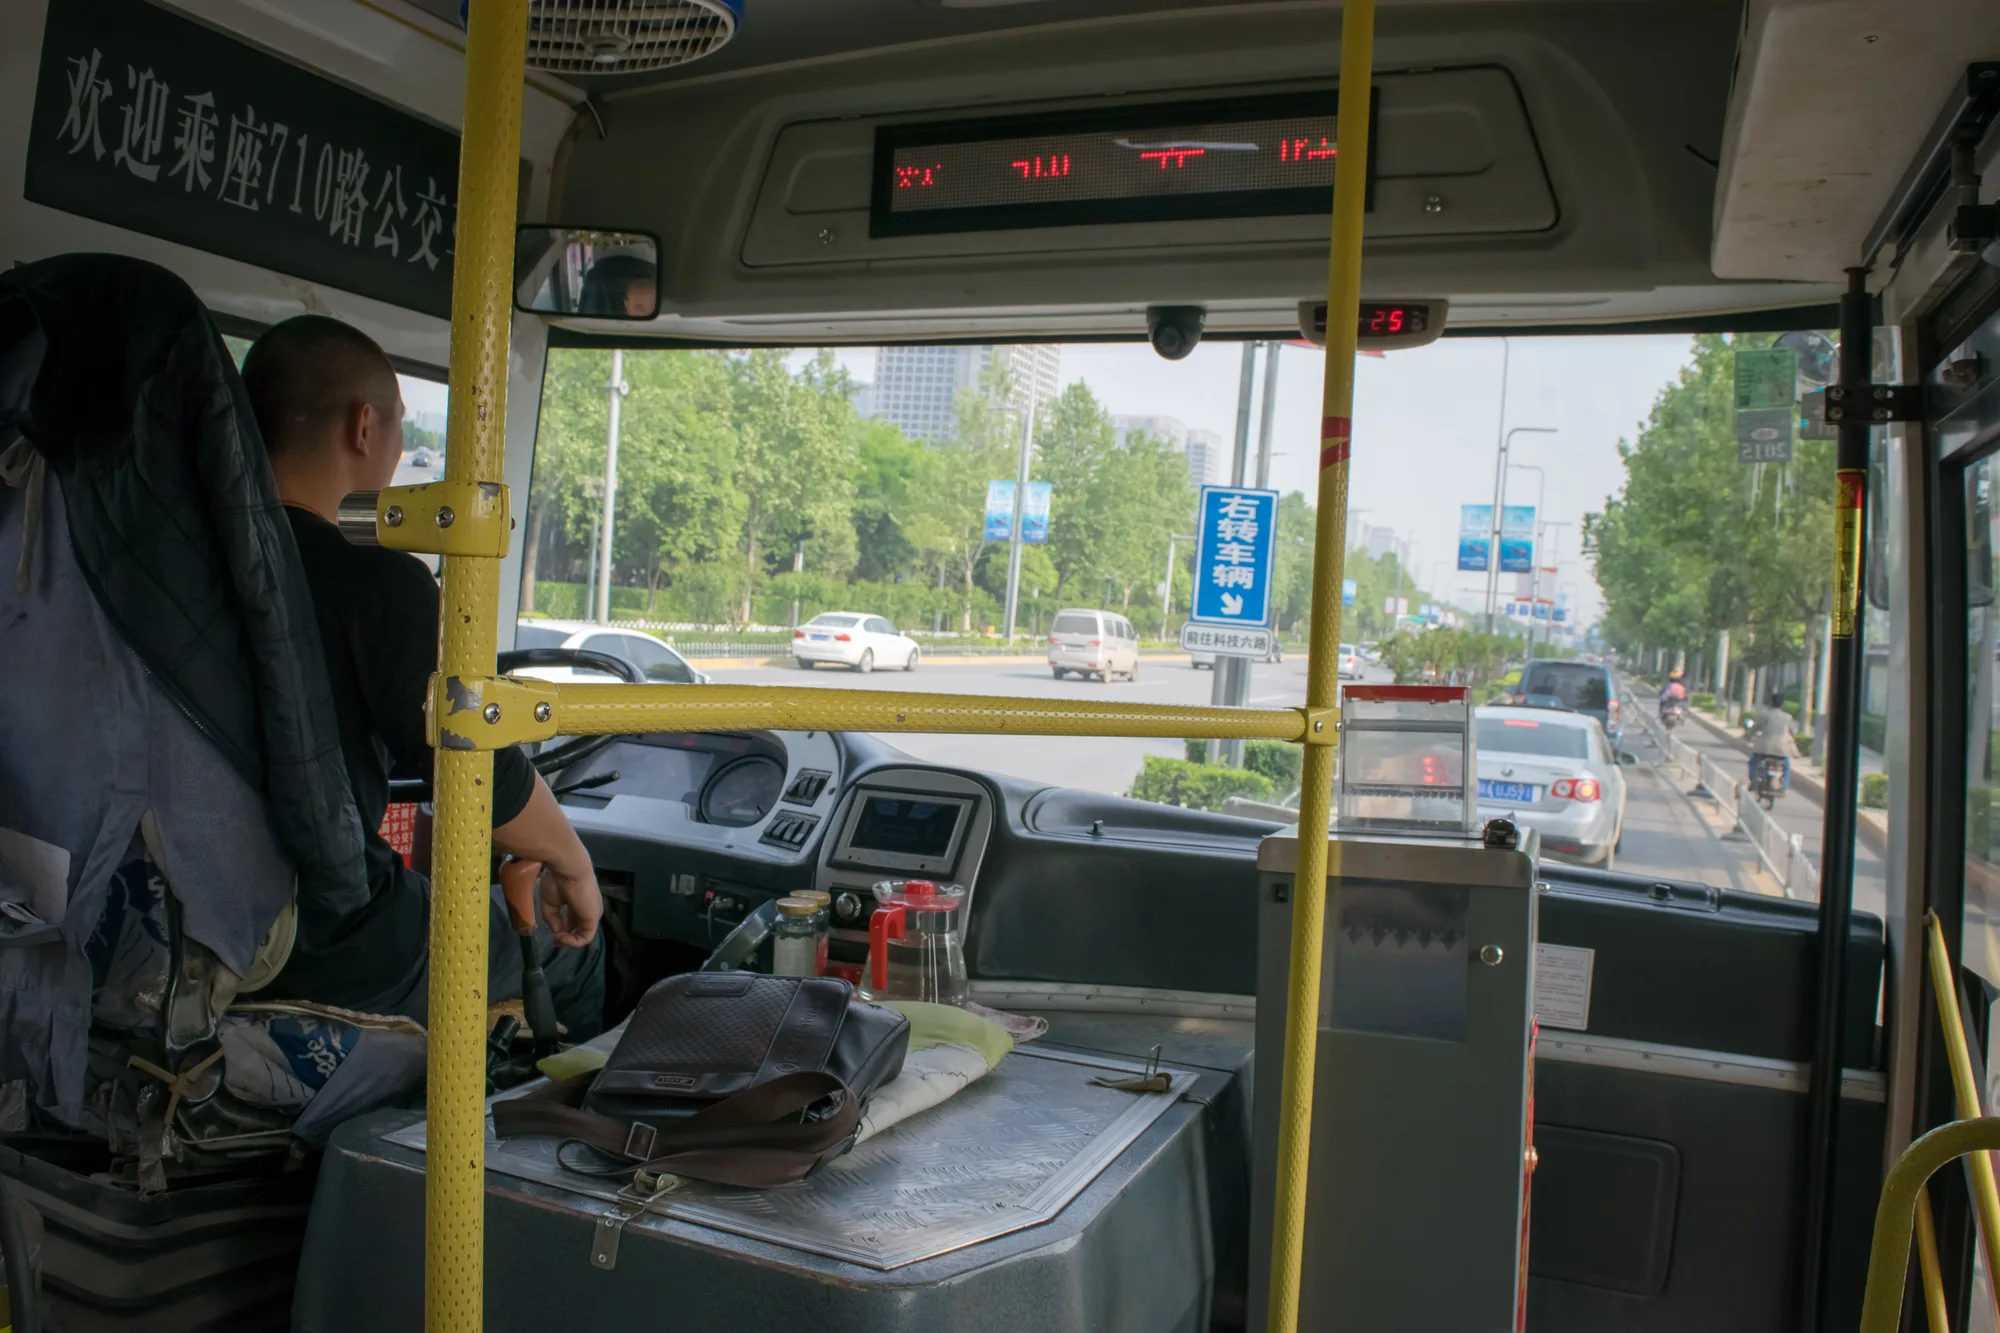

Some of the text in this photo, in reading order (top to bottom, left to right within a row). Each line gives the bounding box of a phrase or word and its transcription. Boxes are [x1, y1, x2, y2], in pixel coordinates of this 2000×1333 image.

[57, 47, 457, 271] 欢迎乘座710路公交
[1370, 309, 1403, 332] 25
[1211, 494, 1261, 590] 右转车辆
[1186, 631, 1267, 650] 前往科技六路
